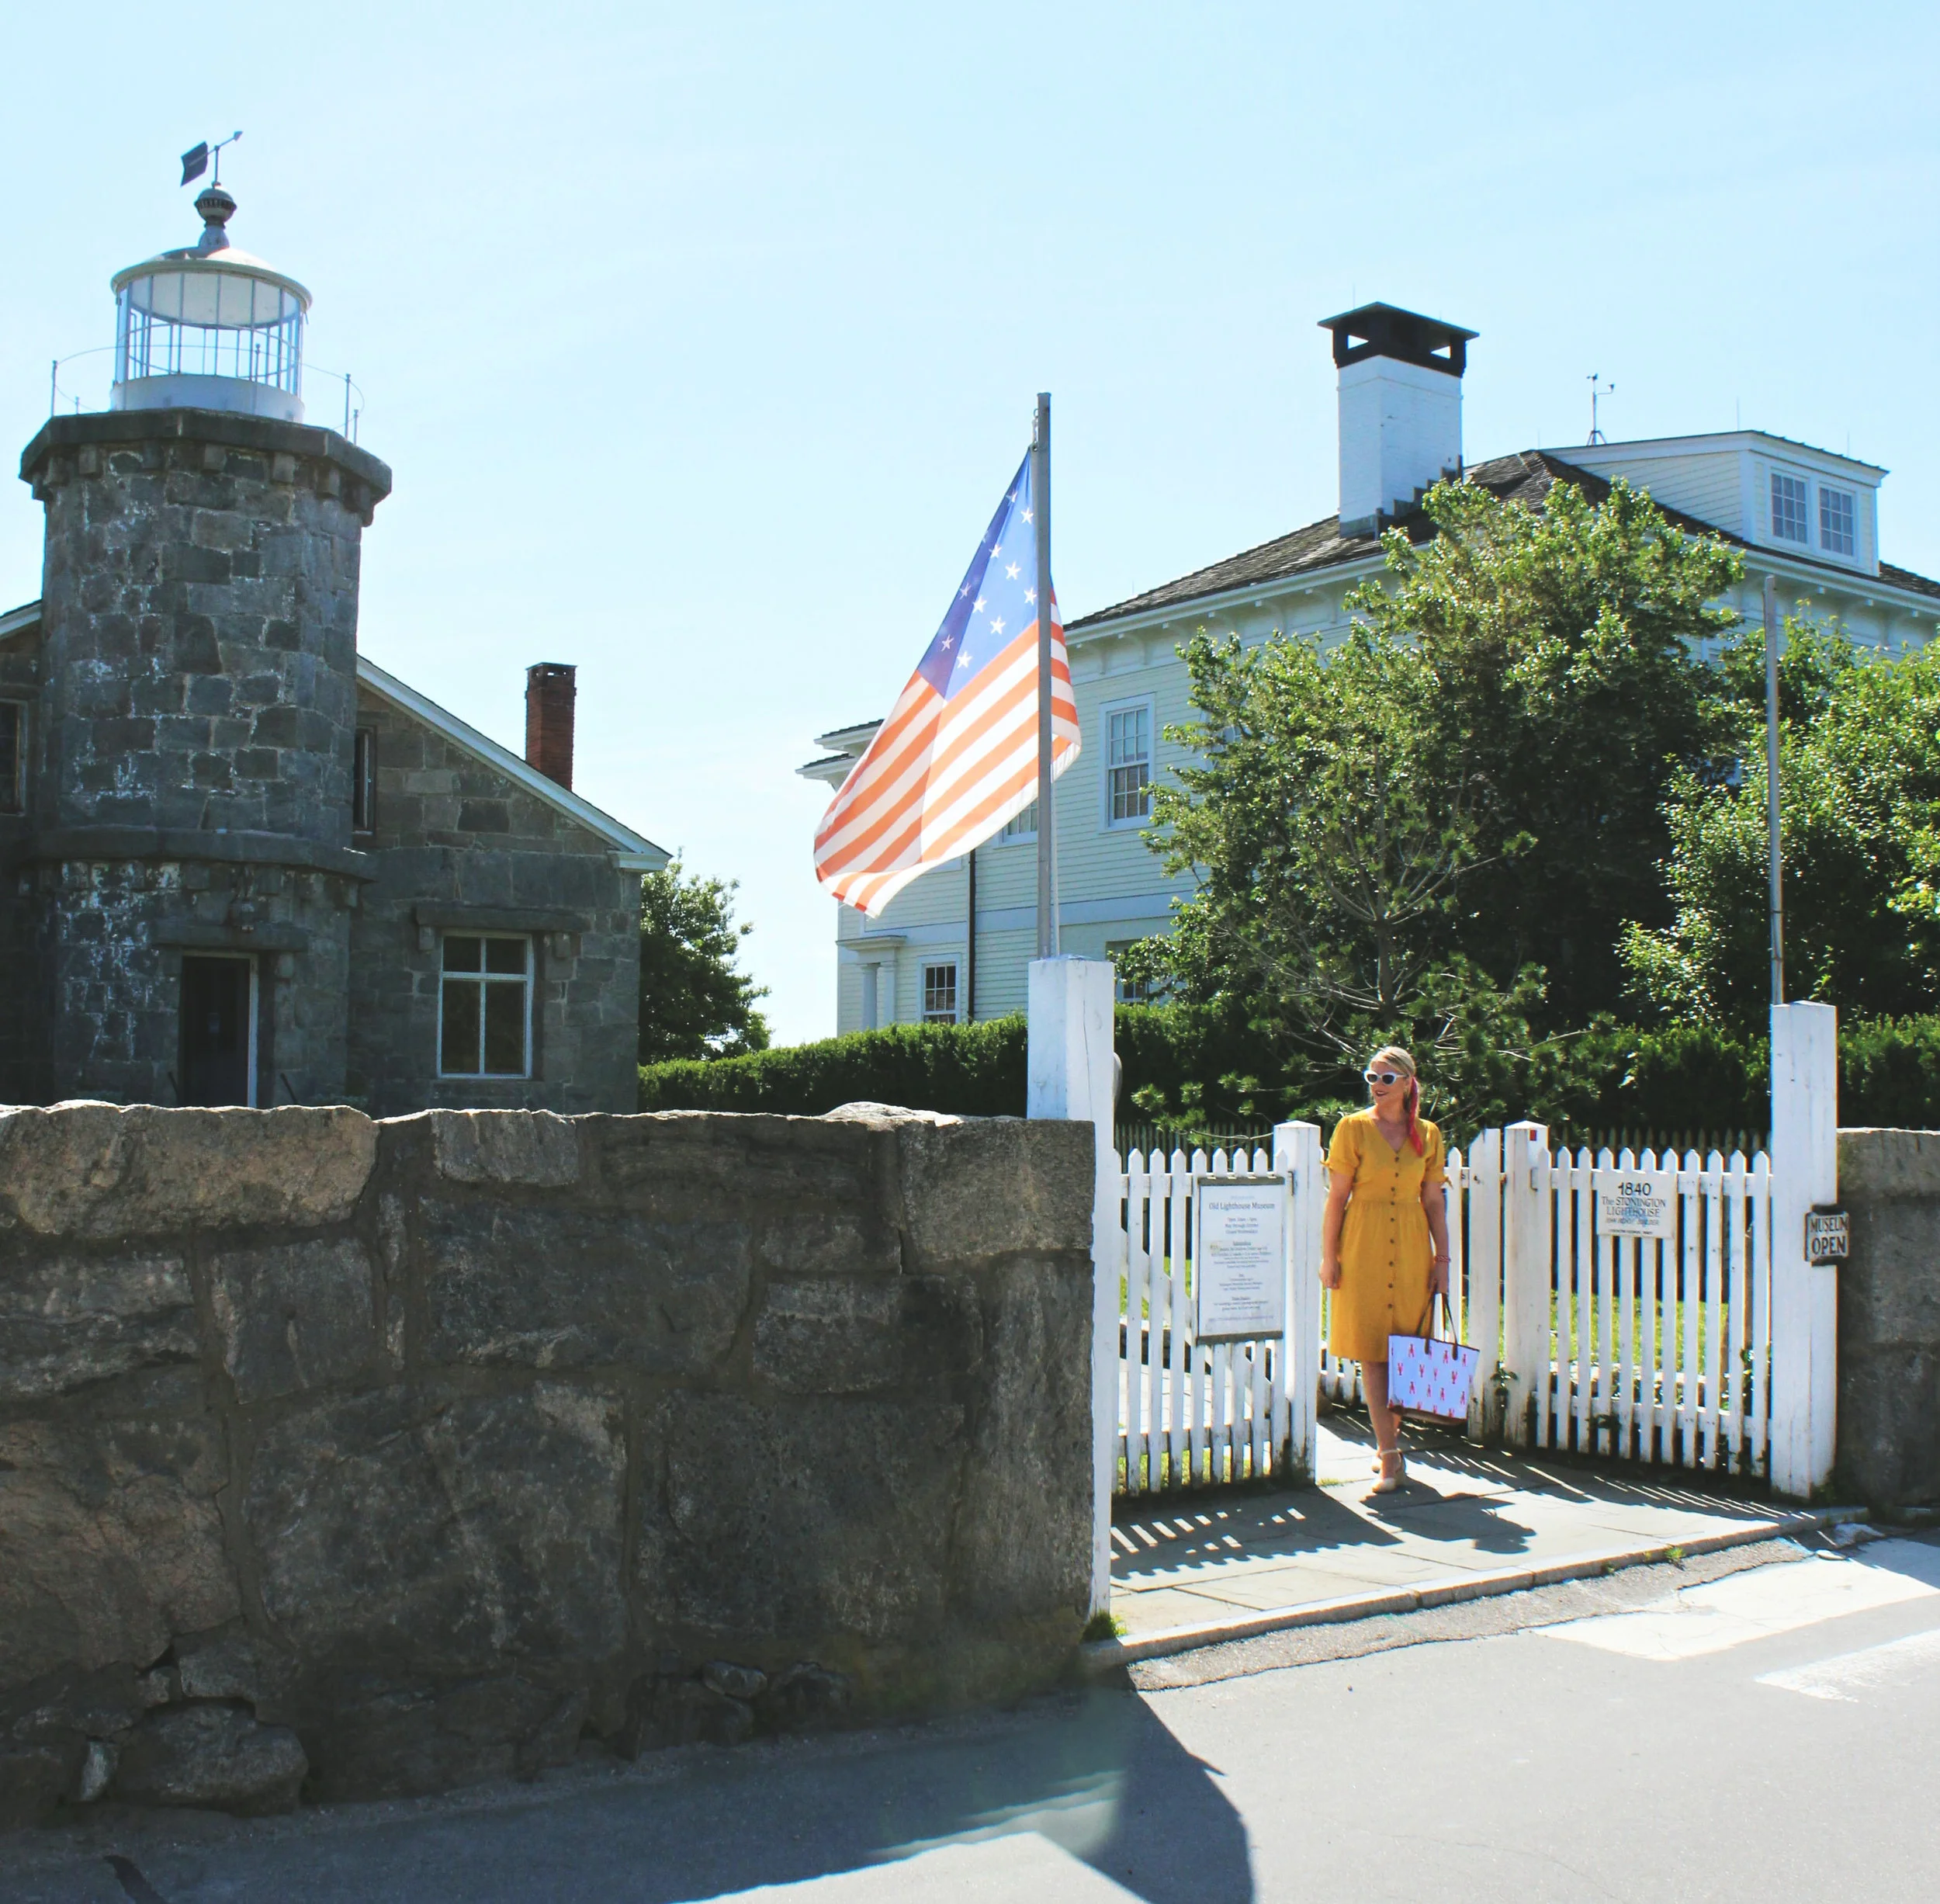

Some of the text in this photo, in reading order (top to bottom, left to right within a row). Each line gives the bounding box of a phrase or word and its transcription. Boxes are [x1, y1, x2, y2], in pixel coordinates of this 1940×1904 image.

[1618, 1182, 1651, 1196] 1840
[1602, 1196, 1666, 1208] The STONINGTON
[1606, 1207, 1661, 1217] LIGHTHOUSE
[1811, 1236, 1847, 1255] OPEN
